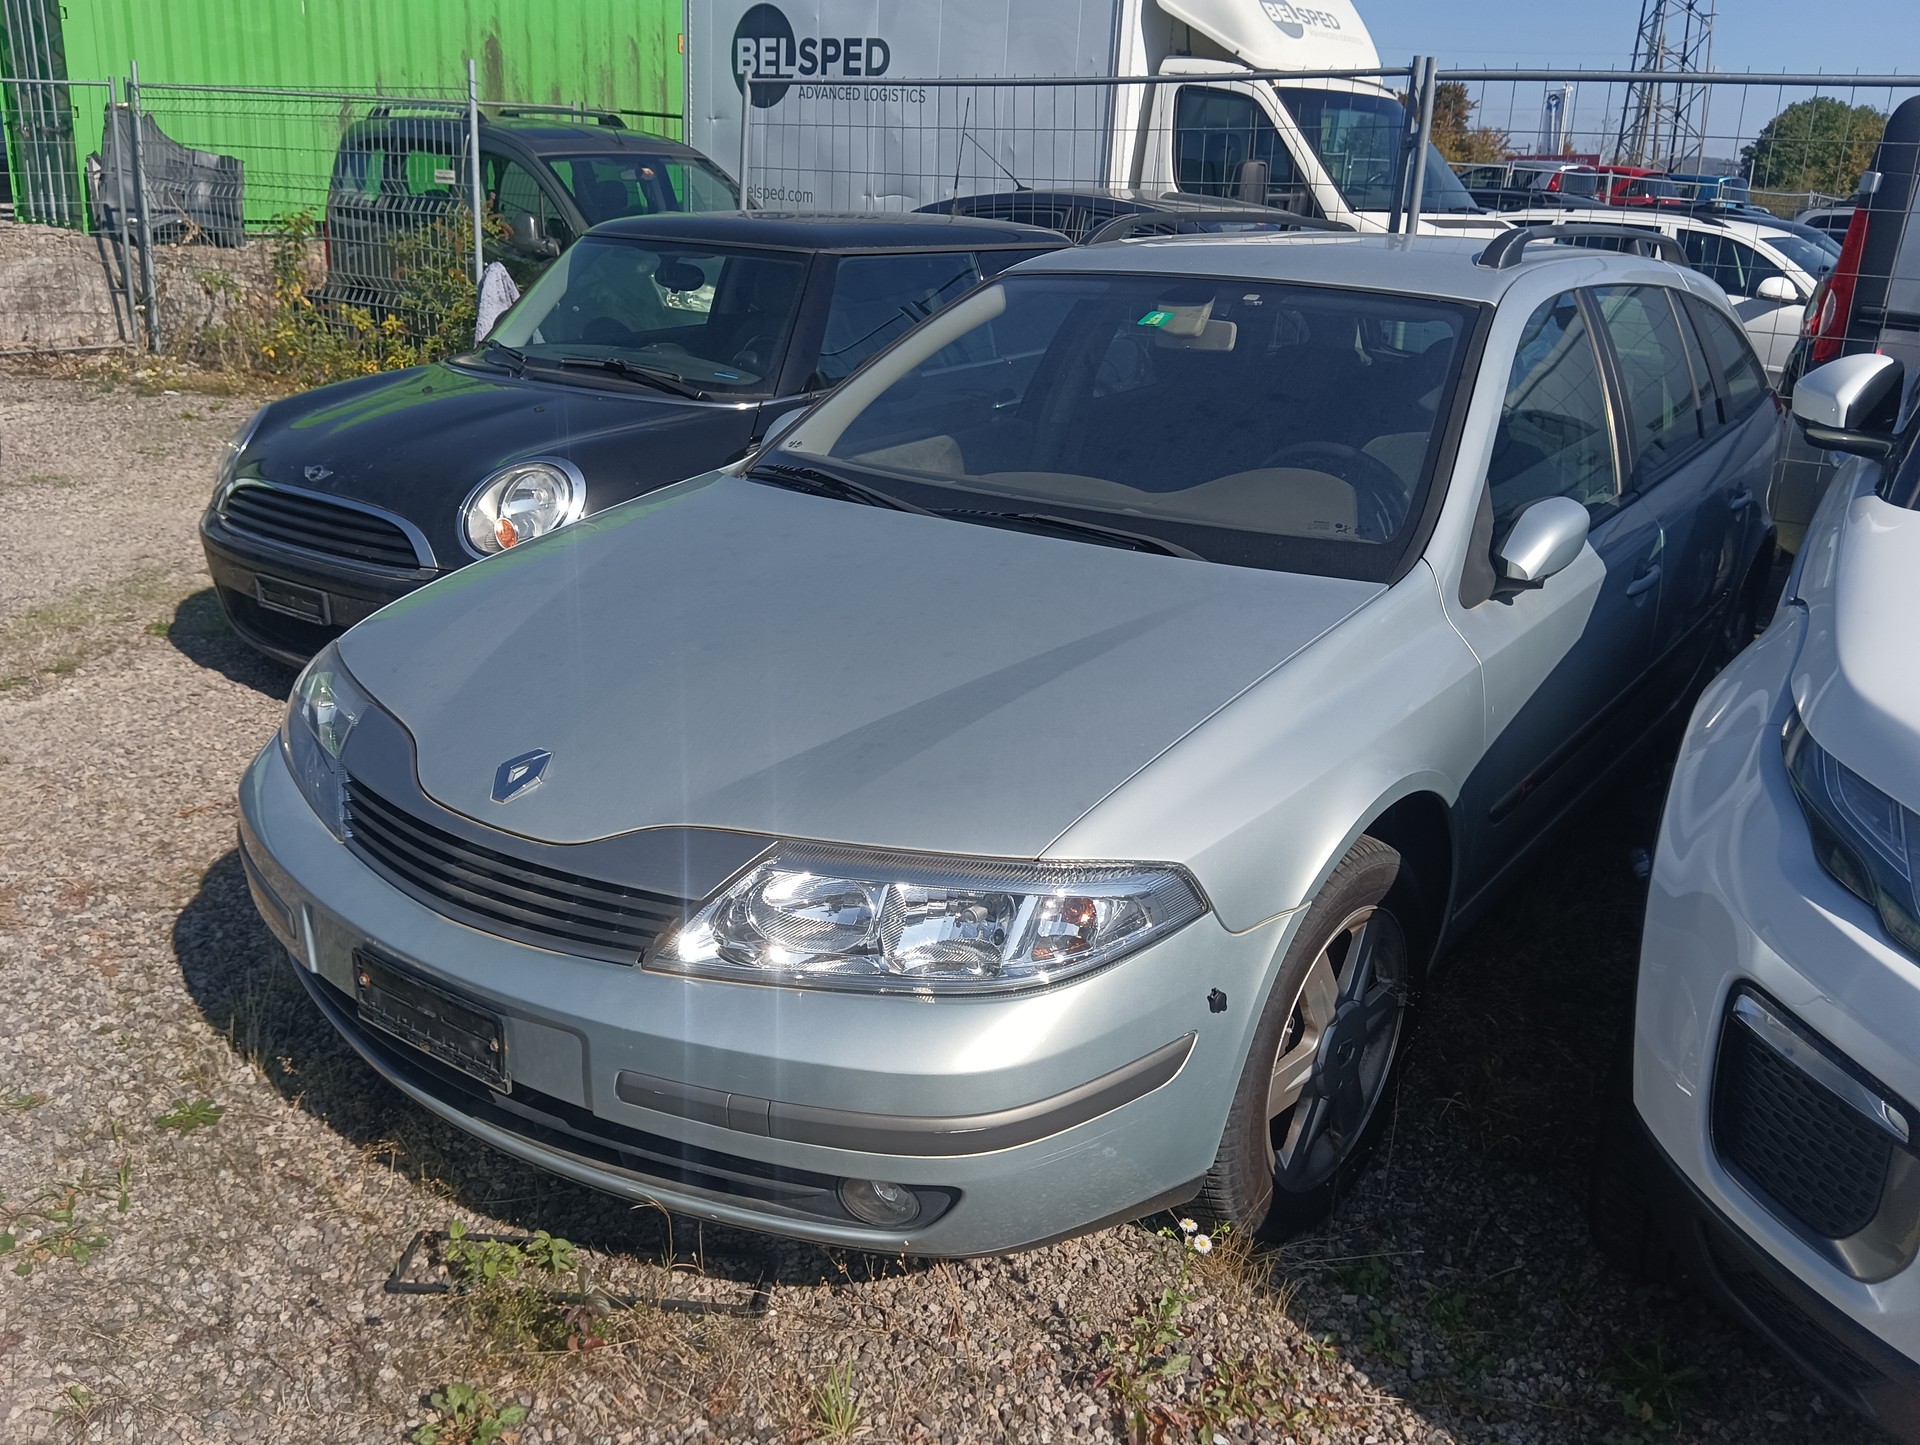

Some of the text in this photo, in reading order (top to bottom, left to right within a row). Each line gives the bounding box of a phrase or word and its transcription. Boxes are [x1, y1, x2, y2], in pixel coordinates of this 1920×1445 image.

[1261, 1, 1341, 30] BELSPED
[736, 37, 890, 77] BELSPED
[798, 86, 926, 103] ADVANCED LOGISTICS
[746, 183, 813, 203] elsped.com
